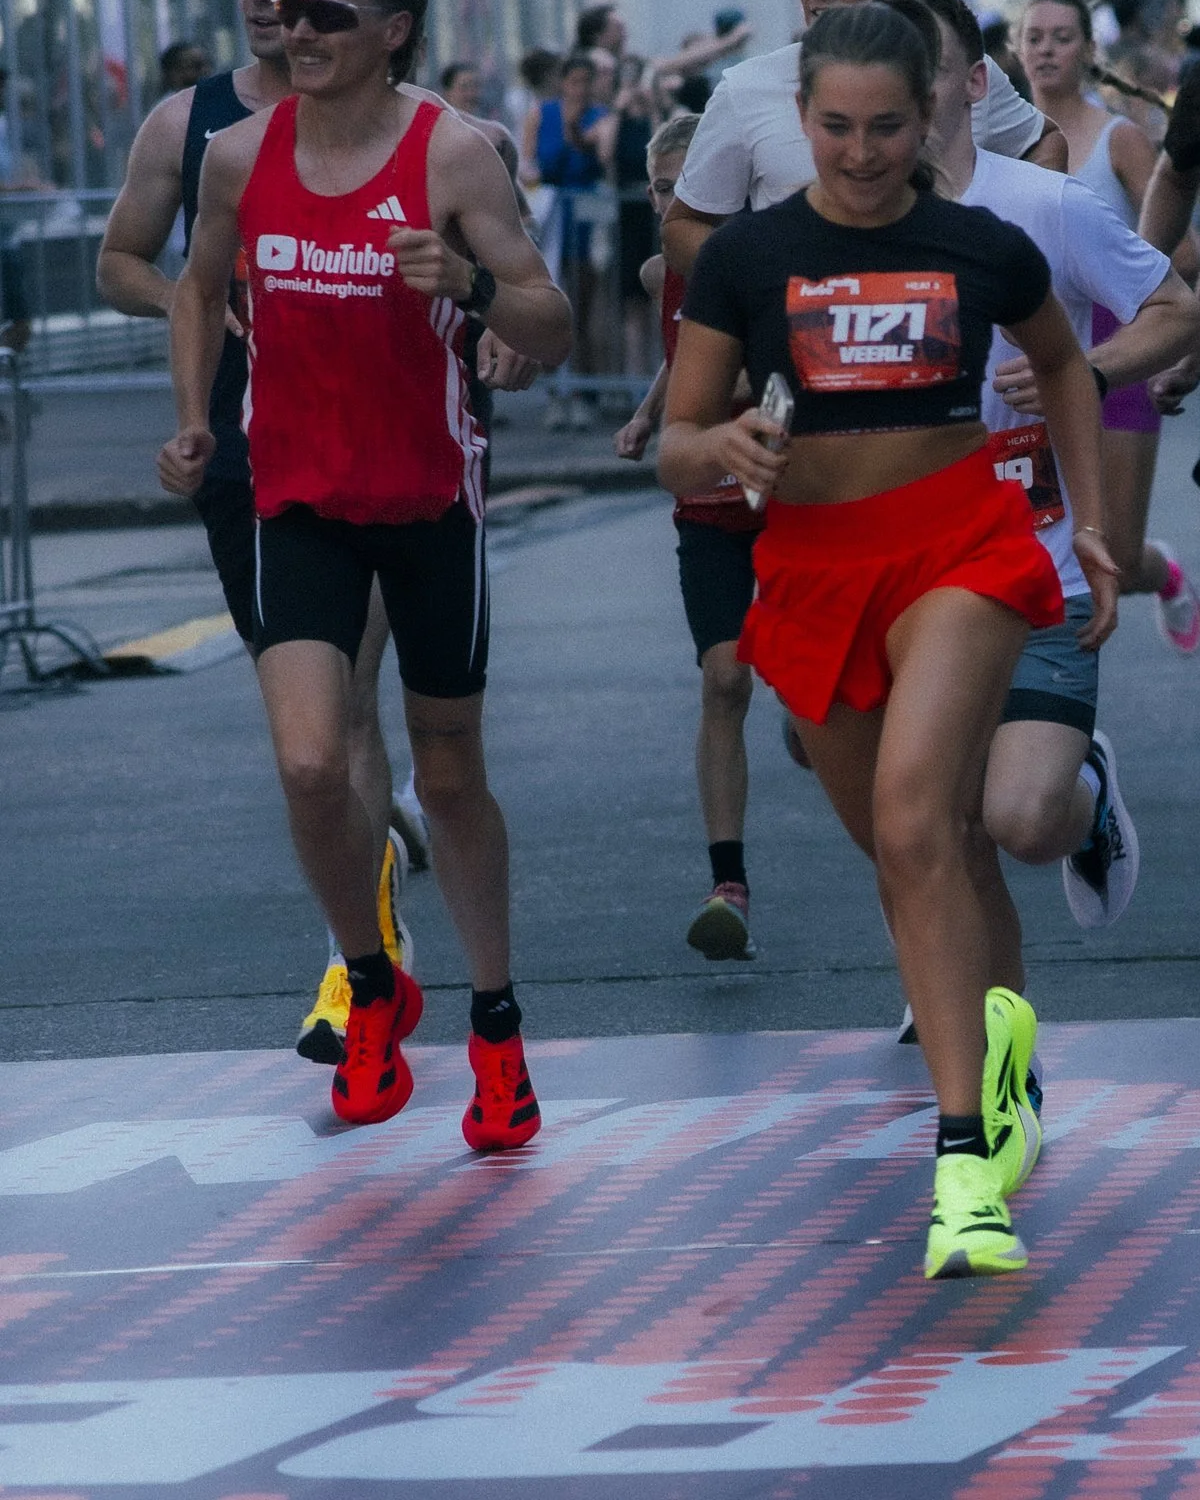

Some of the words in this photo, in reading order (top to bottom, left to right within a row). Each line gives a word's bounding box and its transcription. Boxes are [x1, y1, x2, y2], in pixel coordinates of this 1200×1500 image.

[301, 240, 395, 276] YouTube
[264, 275, 383, 299] @emiel.berghout
[828, 303, 927, 343] 1171
[839, 345, 914, 364] VEERLE
[1007, 436, 1029, 447] HEAT
[1031, 434, 1037, 442] 3
